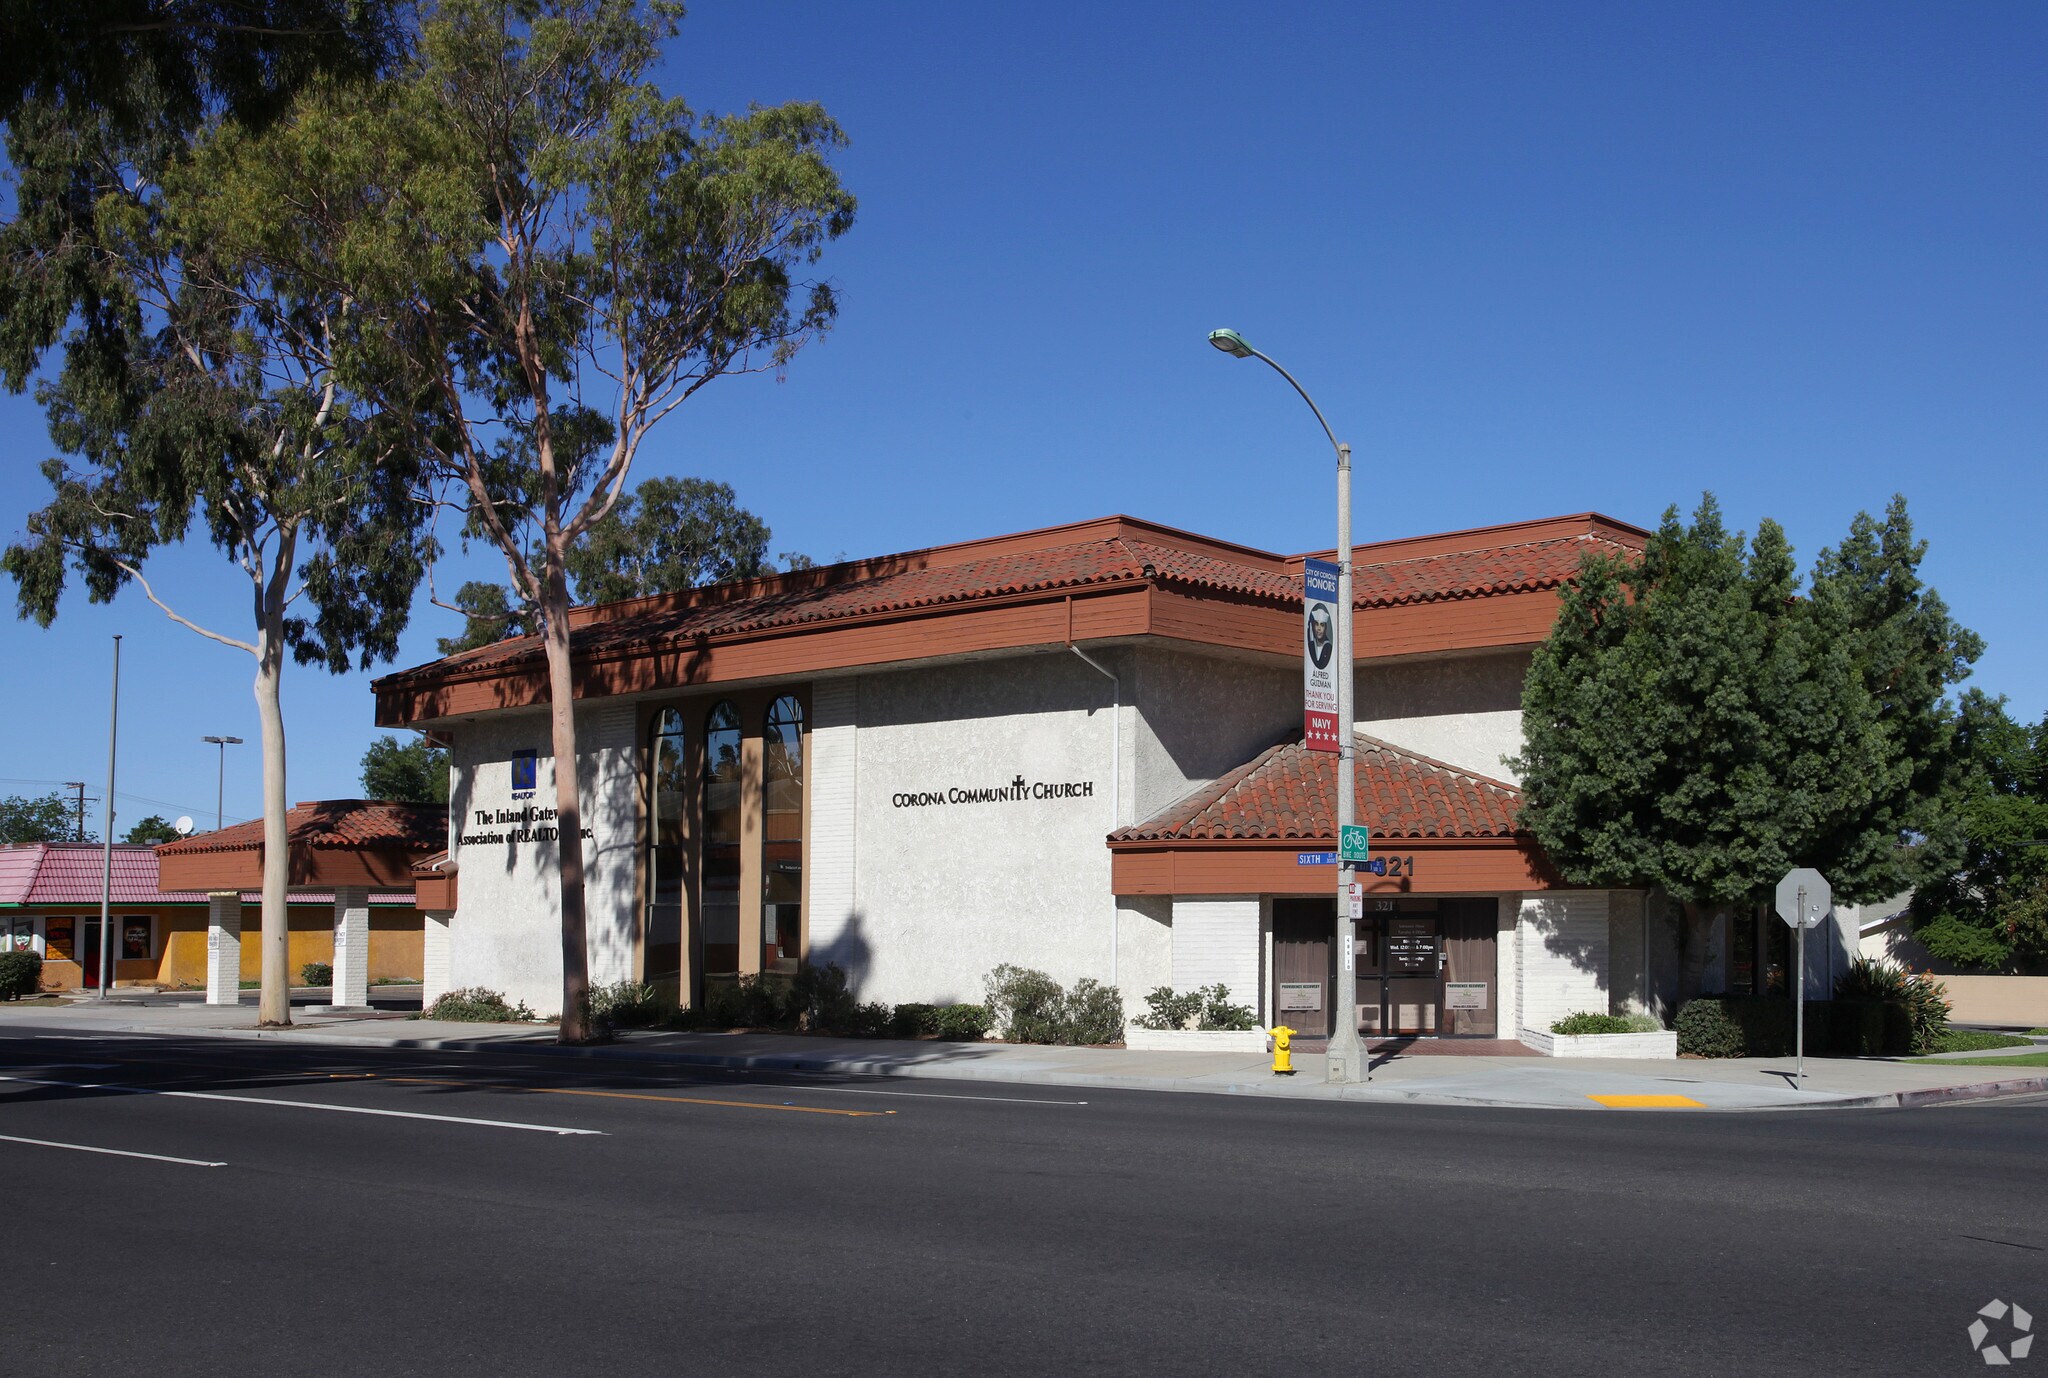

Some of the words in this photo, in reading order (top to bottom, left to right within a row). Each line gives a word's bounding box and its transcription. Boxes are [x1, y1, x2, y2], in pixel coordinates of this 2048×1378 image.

[1320, 571, 1337, 581] CORONA
[1307, 576, 1336, 593] HONORS
[1313, 670, 1330, 680] ALFRED
[1310, 678, 1332, 690] GUZMAN
[1305, 689, 1322, 700] THANK
[1322, 692, 1335, 702] YOU
[1305, 699, 1315, 709] FOR
[1315, 700, 1338, 712] SERVING
[1312, 717, 1332, 730] NAVY
[892, 791, 946, 808] CORONA
[1032, 781, 1094, 800] CHURCH
[475, 810, 494, 826] The
[496, 807, 528, 824] Inland
[457, 831, 504, 846] Association
[505, 832, 516, 843] of
[517, 827, 559, 843] REALTO
[580, 827, 594, 840] nc.
[1299, 854, 1321, 864] SIXTH
[1343, 850, 1352, 858] BIKE
[1353, 851, 1367, 859] ROUTE
[1375, 901, 1394, 911] 321
